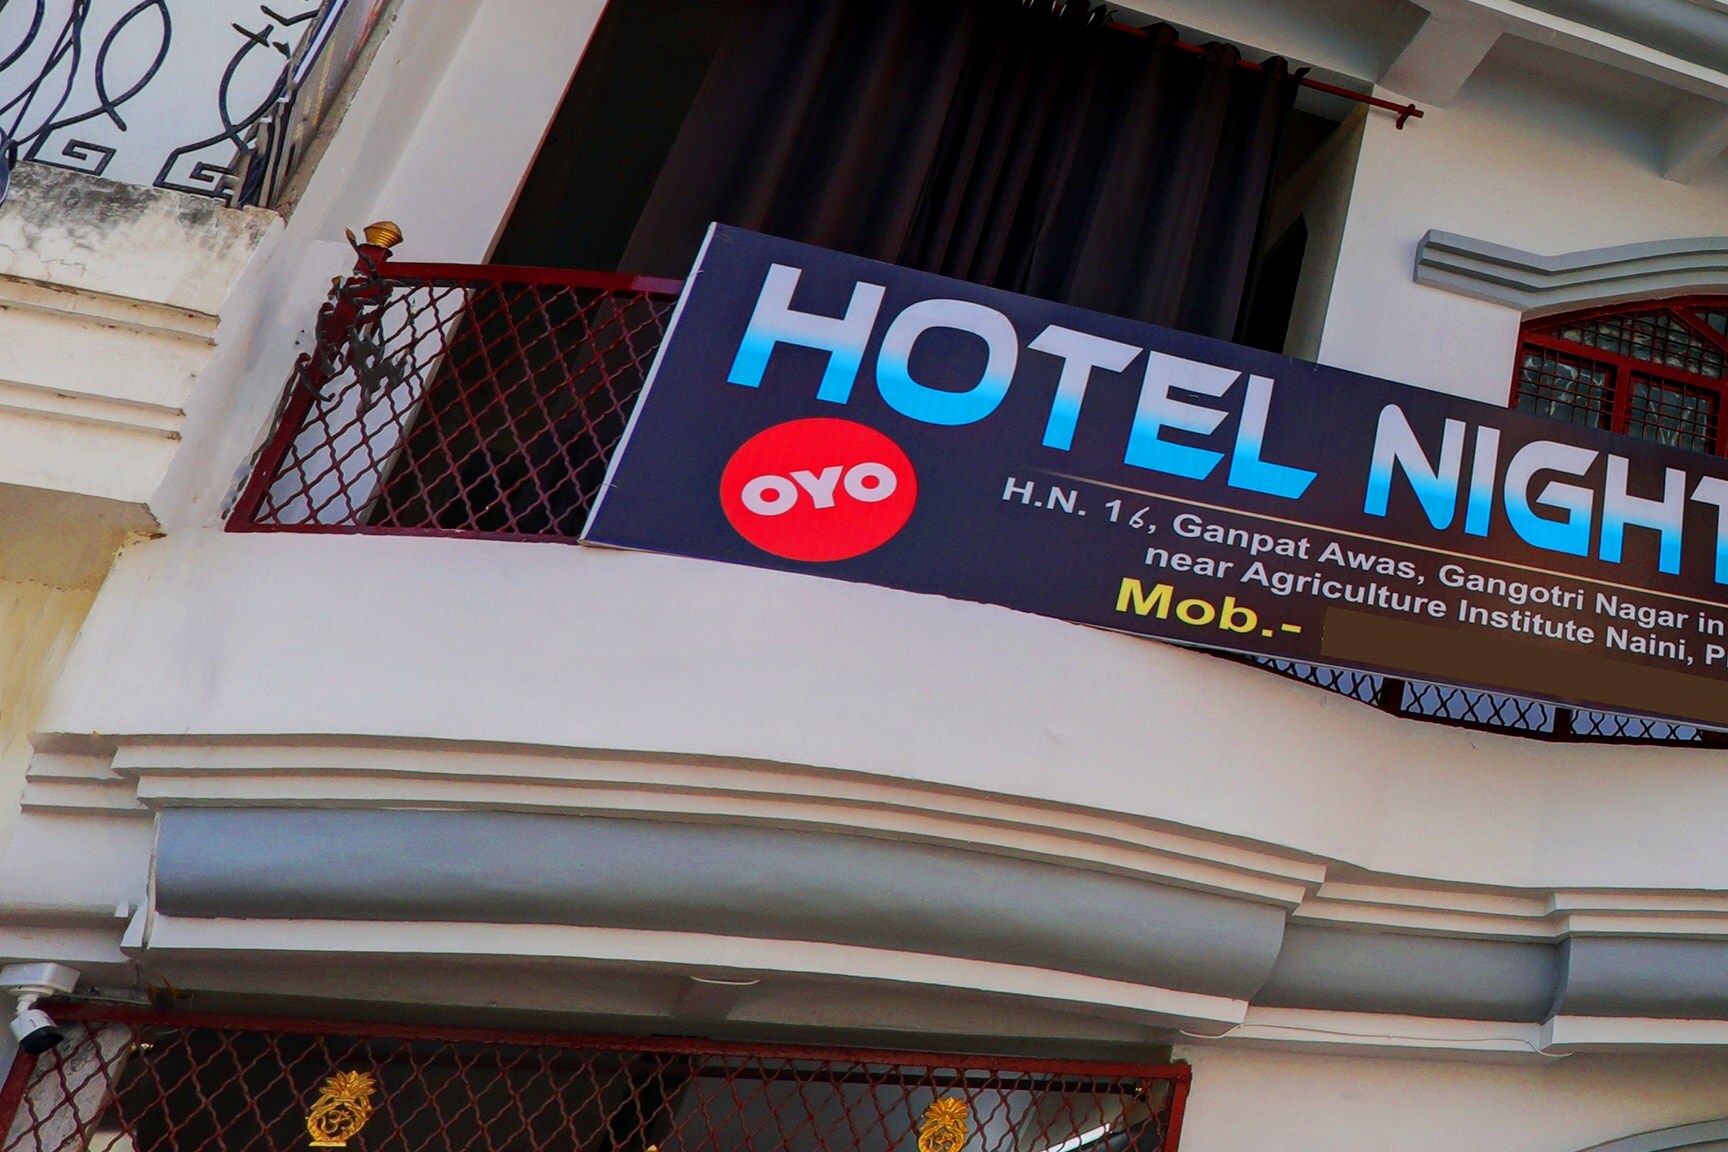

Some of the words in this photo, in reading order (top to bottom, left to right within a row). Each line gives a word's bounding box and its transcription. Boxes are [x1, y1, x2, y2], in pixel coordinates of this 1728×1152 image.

[727, 263, 1318, 500] HOTEL
[741, 461, 897, 516] OYO
[1002, 477, 1086, 516] H.N.
[1172, 513, 1311, 558] Ganpat
[1318, 542, 1426, 585] Awas,
[1438, 564, 1584, 611] Gangotri
[1595, 592, 1689, 629] Nagar
[1698, 612, 1724, 636] in
[1145, 547, 1233, 579] near
[1240, 561, 1447, 618] Agriculture
[1458, 599, 1595, 645] Institute
[1605, 626, 1694, 666] Naini,
